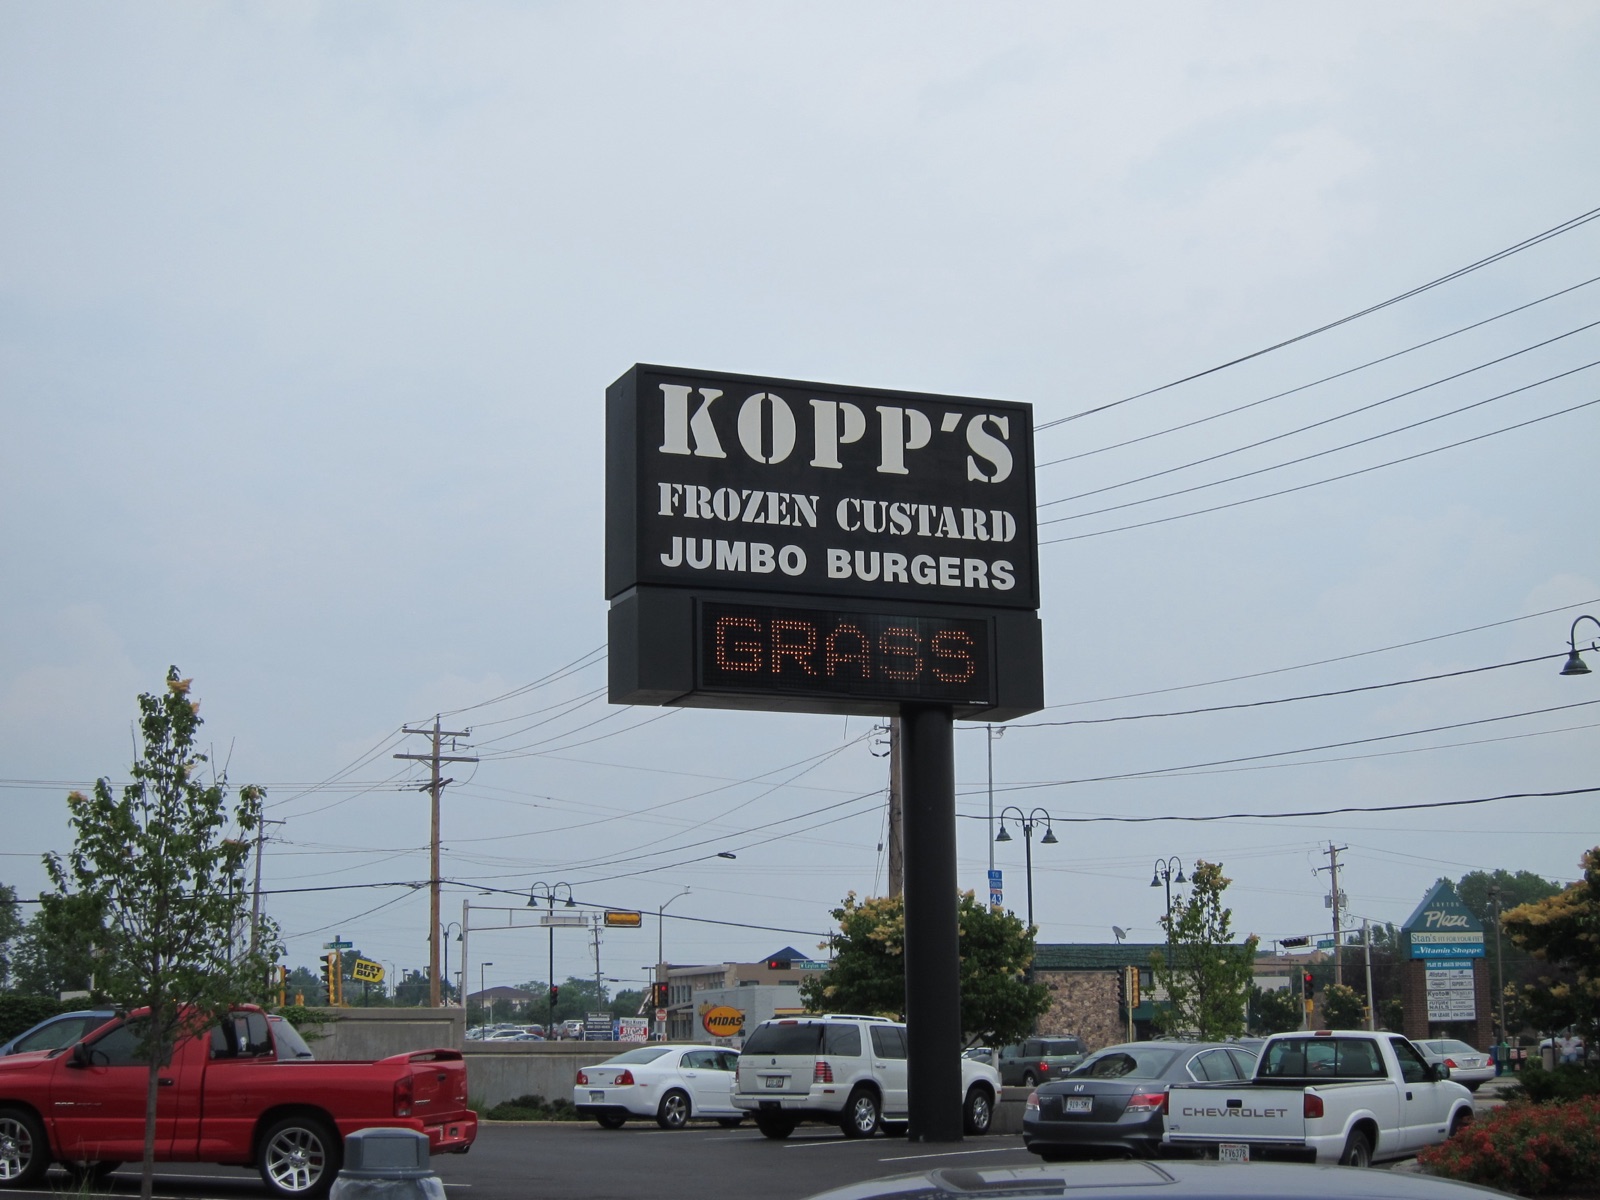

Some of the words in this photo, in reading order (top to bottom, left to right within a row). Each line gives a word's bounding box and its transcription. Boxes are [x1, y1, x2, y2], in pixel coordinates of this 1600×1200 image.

[658, 382, 1013, 484] KOPP'S
[657, 482, 819, 529] FROZEN
[836, 497, 1017, 543] CUSTARD
[660, 536, 807, 577] JUMBO
[826, 548, 1016, 593] BURGERS
[715, 615, 975, 684] GRASS
[991, 894, 1002, 905] 43
[1423, 910, 1470, 928] Plaza
[1411, 933, 1437, 942] Stan's
[1420, 946, 1451, 954] Vitamin
[356, 962, 382, 972] BEST
[356, 970, 378, 979] BUY
[708, 1016, 742, 1026] MIDAS
[1182, 1108, 1288, 1118] CHEVROLET
